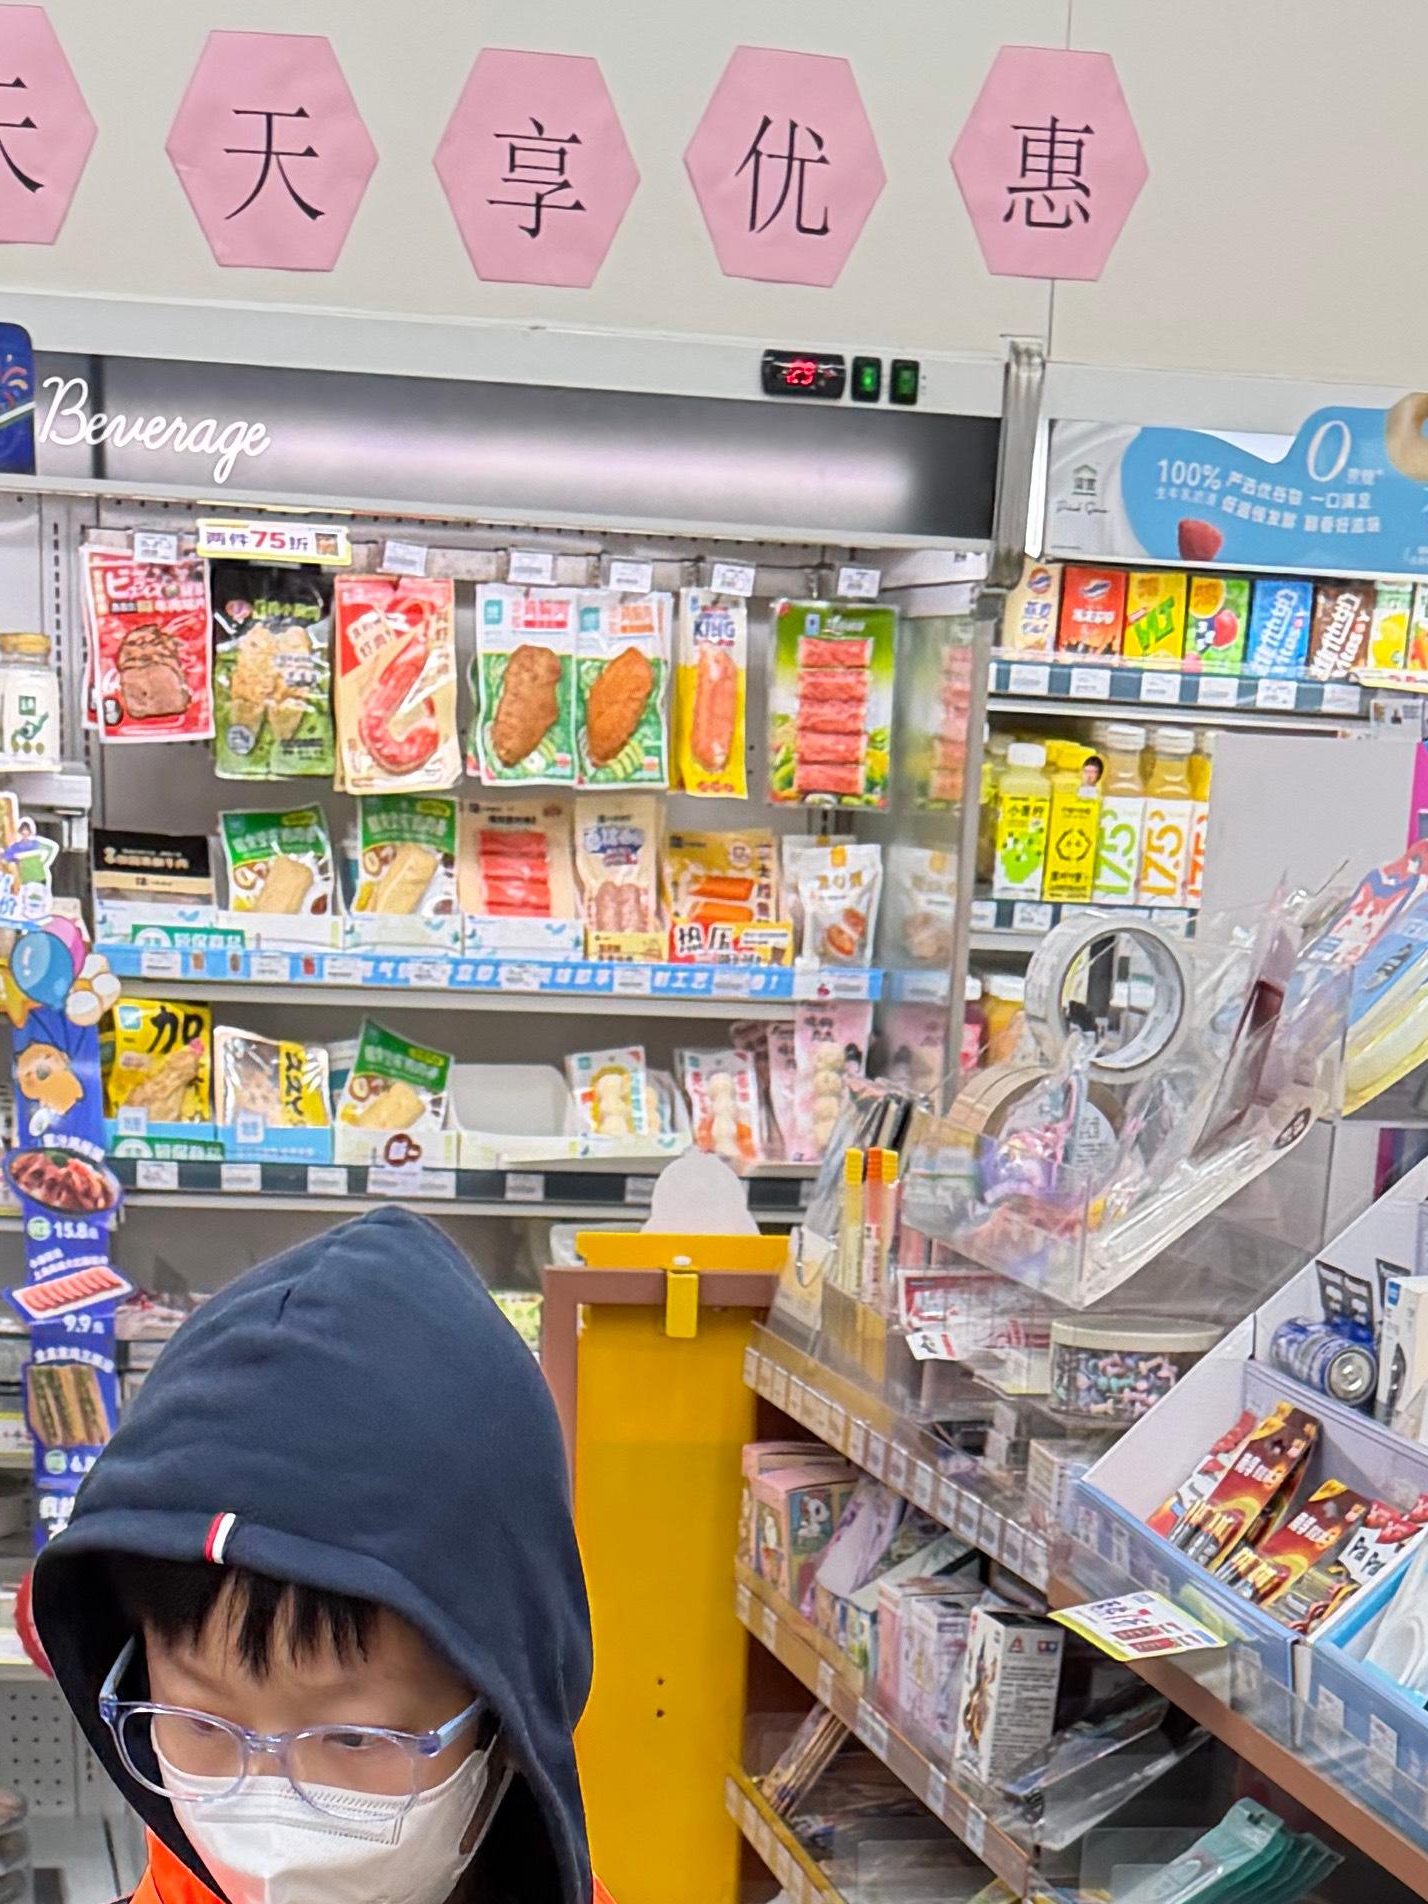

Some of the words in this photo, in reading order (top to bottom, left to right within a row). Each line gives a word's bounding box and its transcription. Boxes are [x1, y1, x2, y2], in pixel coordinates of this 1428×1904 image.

[224, 106, 326, 221] 天
[486, 116, 587, 239] 享
[734, 114, 832, 236] 优
[1001, 115, 1096, 230] 惠
[39, 377, 272, 484] Beverage
[1157, 458, 1222, 492] 100%
[205, 529, 311, 553] 两件75折
